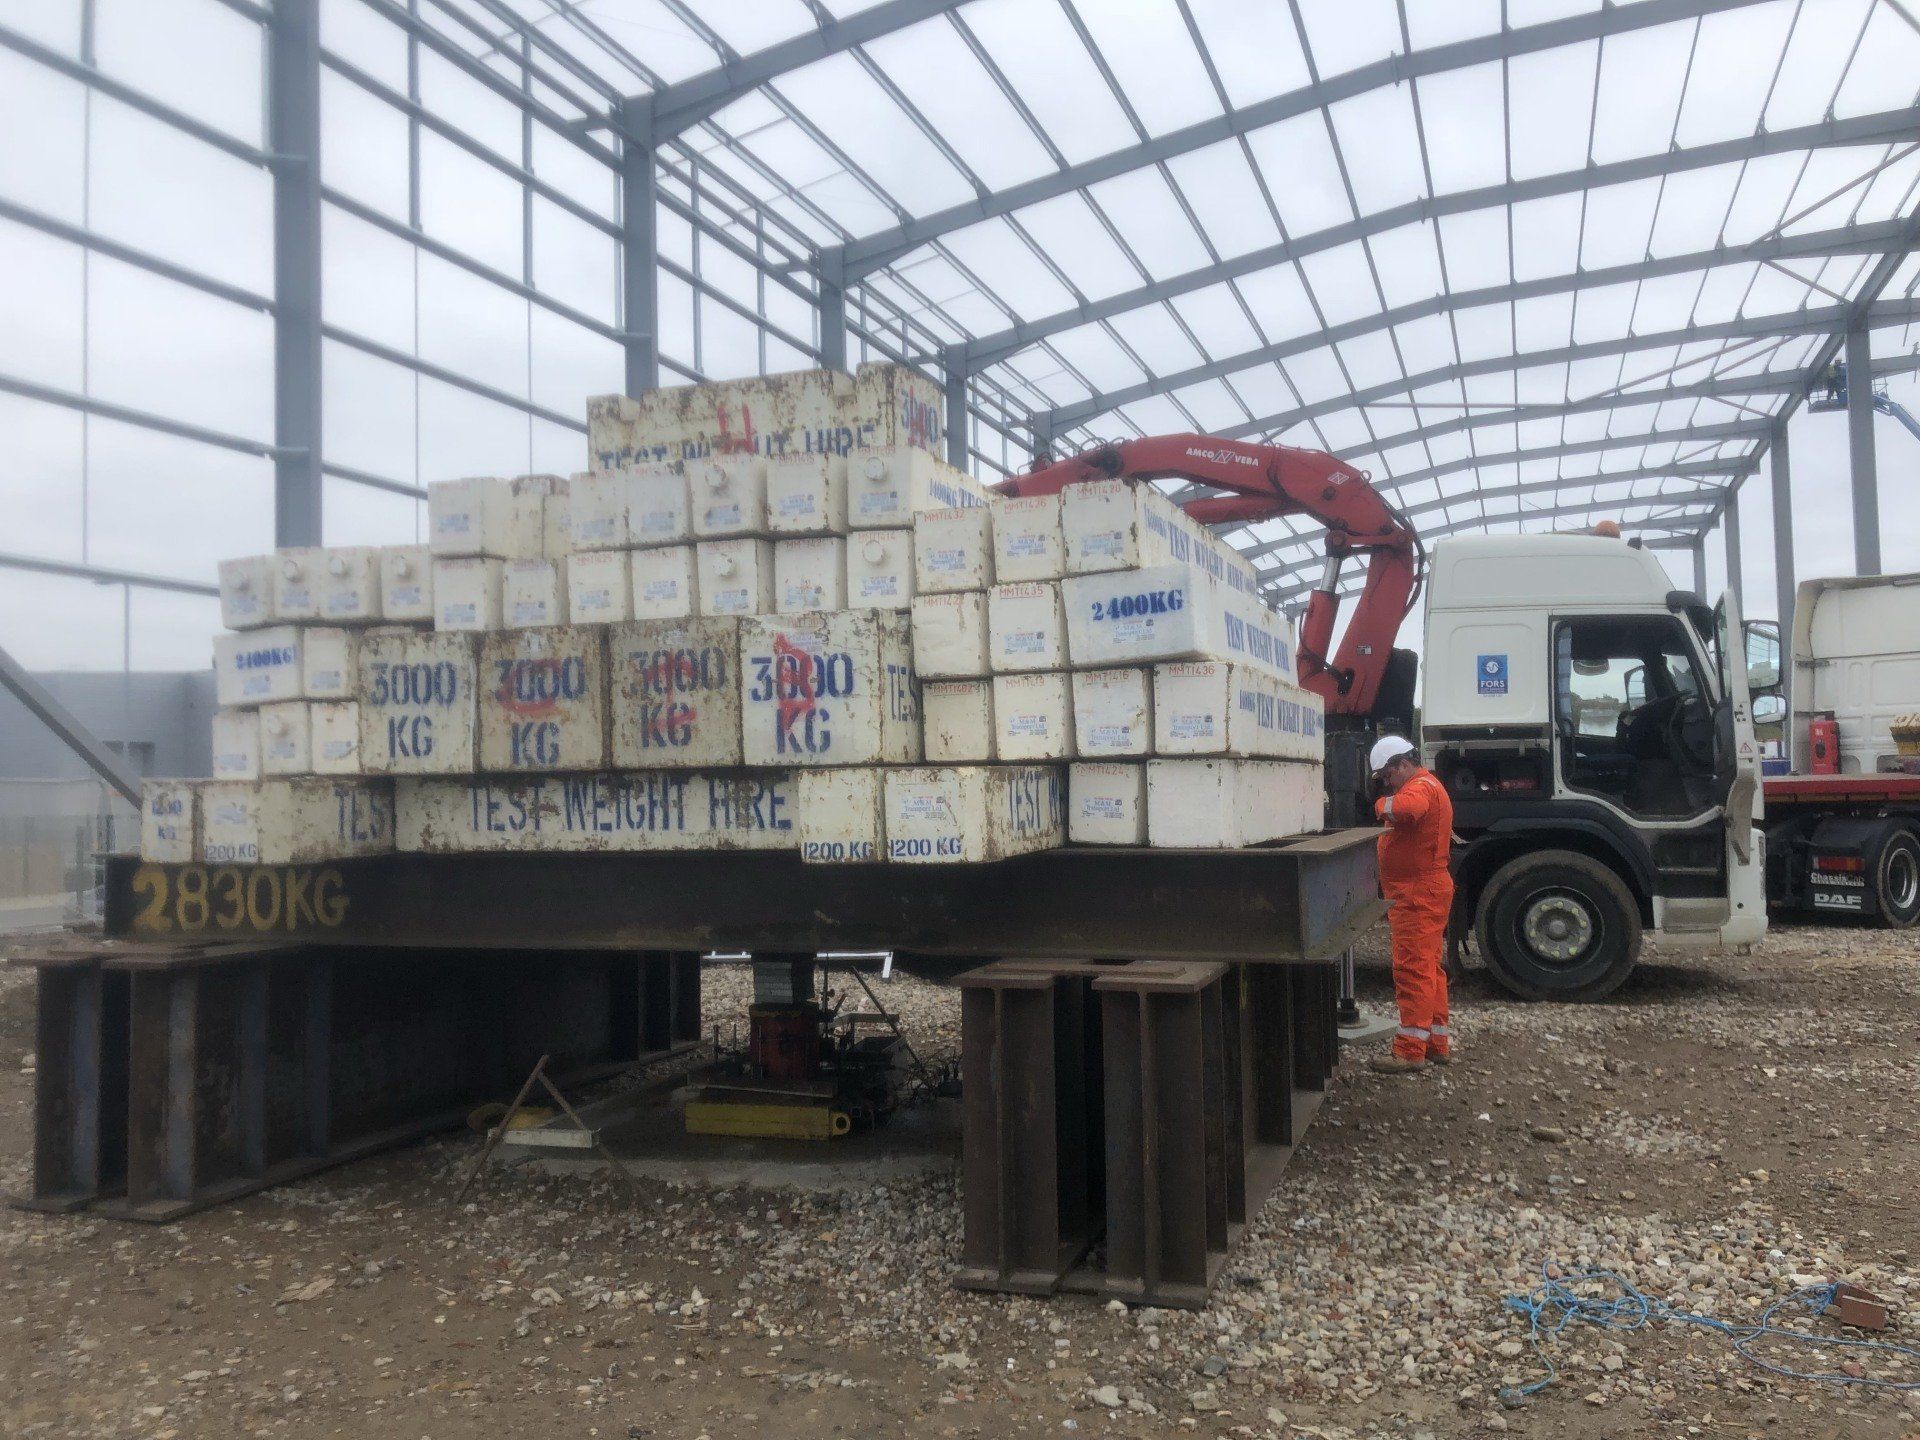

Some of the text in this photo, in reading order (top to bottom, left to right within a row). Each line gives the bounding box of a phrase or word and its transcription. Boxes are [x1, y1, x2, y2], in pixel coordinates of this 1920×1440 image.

[1185, 447, 1259, 467] AMCO VEBA
[1168, 521, 1190, 564] TEST
[1091, 588, 1183, 621] 2400KG
[1224, 610, 1245, 653] TEST
[370, 661, 457, 707] 3000
[494, 656, 587, 702] 3000
[628, 646, 726, 699] 3000
[750, 651, 854, 702] 3000
[1168, 664, 1216, 677] MMT1436
[1480, 680, 1505, 688] FORS
[640, 702, 692, 748] KG
[776, 707, 831, 754] KG
[1256, 691, 1274, 730] TEST
[1276, 698, 1301, 734] WEIGHT
[388, 714, 433, 759] KG
[511, 721, 560, 765] KG
[470, 772, 793, 833] TEST WEIGHT HIRE
[1007, 769, 1041, 833] TEST
[239, 843, 257, 859] KG
[803, 841, 874, 860] 1200 KG
[889, 836, 962, 857] 1200 KG
[1814, 893, 1862, 905] DAF
